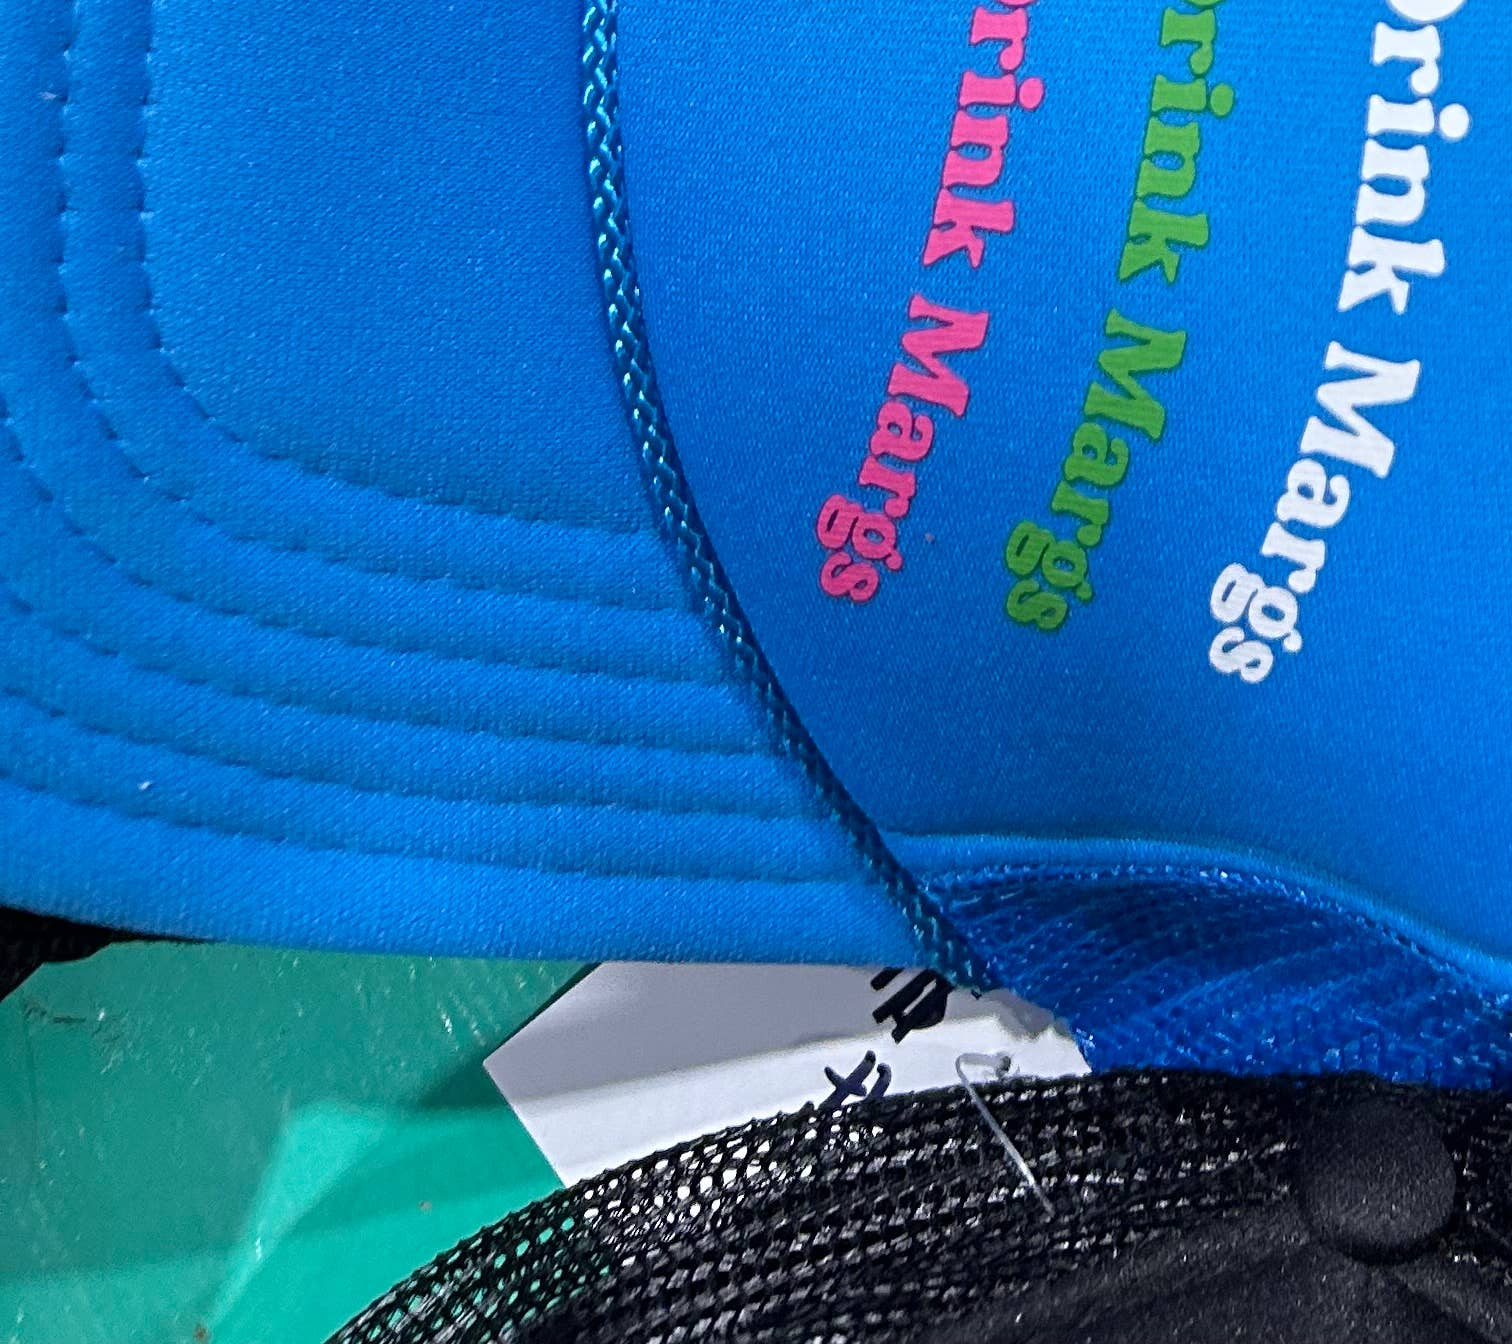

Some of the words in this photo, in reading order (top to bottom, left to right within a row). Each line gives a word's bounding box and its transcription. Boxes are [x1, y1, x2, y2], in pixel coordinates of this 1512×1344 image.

[814, 293, 990, 604] Margs
[1004, 308, 1188, 633] Margs
[1208, 341, 1422, 684] Margs
